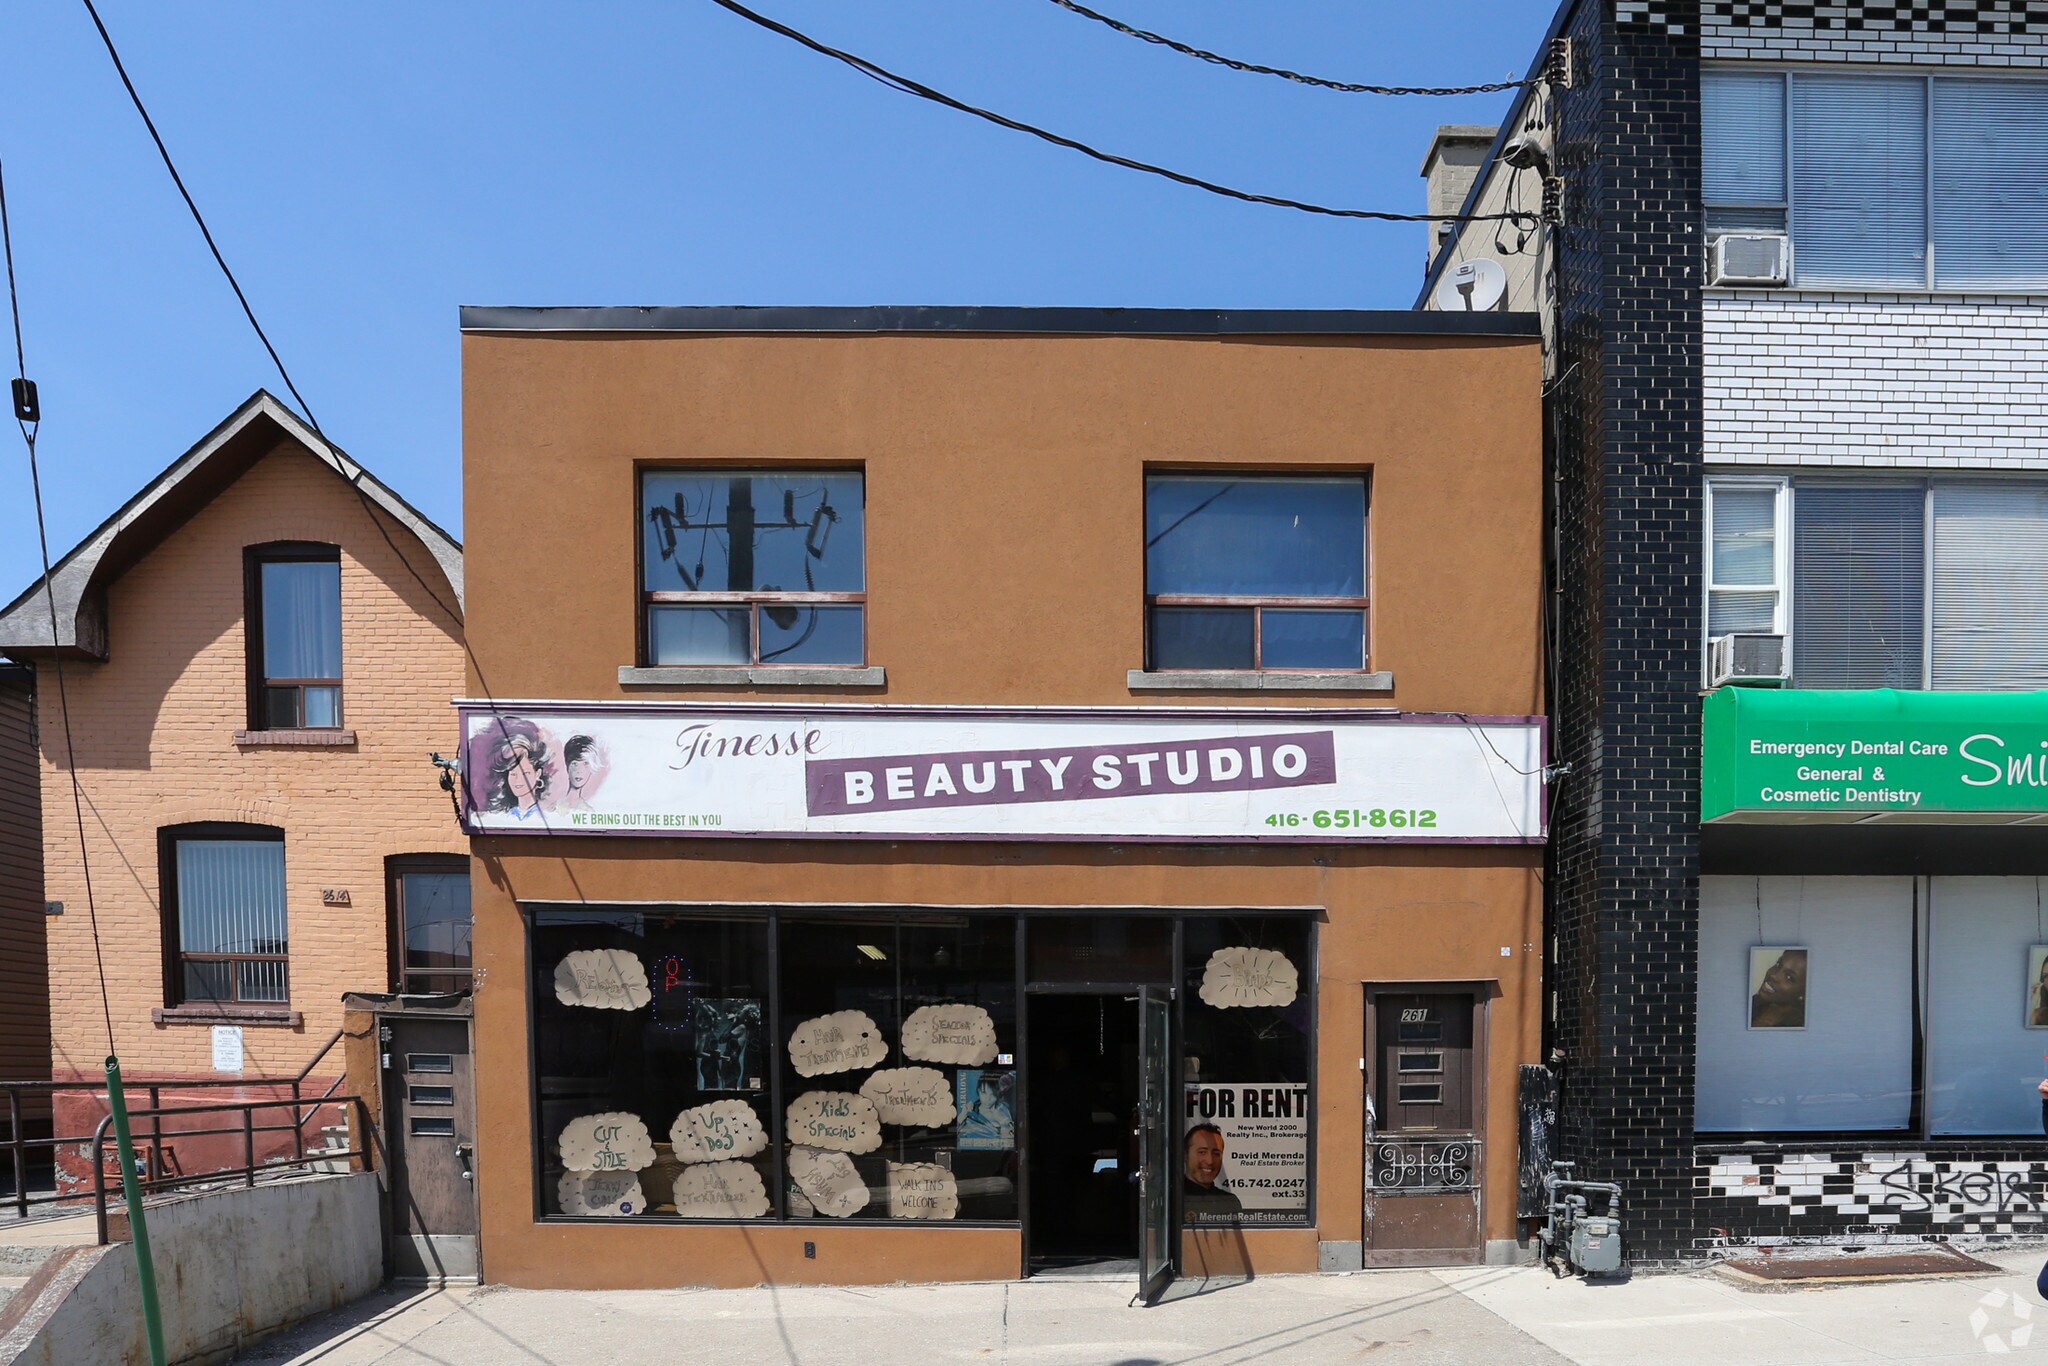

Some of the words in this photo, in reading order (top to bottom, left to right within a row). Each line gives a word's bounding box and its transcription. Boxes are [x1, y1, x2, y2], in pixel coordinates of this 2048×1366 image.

[668, 719, 832, 770] Finesse
[1750, 740, 1846, 758] Emergency
[1851, 740, 1904, 755] Dental
[1909, 741, 1949, 755] Care
[844, 755, 1074, 806] BEAUTY
[1091, 743, 1309, 791] STUDIO
[1796, 766, 1863, 781] General
[1872, 766, 1885, 781] &
[1760, 787, 1840, 802] Cosmetic
[1845, 788, 1922, 806] Dentistry
[571, 813, 588, 825] WE
[591, 813, 621, 825] BRING
[622, 814, 641, 825] OUT
[643, 814, 661, 825] THE
[663, 814, 686, 826] BEST
[689, 815, 699, 826] IN
[701, 814, 722, 826] YOU
[1402, 1009, 1425, 1021] 261
[1186, 1088, 1235, 1119] FOR
[1242, 1088, 1308, 1118] RENT
[593, 1125, 622, 1143] CUT
[898, 1178, 921, 1191] WALK
[1221, 1179, 1305, 1188] 416.742.0247
[900, 1194, 940, 1209] WELCOME
[1271, 1190, 1305, 1198] ext.33
[1199, 1212, 1307, 1221] MerendaRealEstate.com
